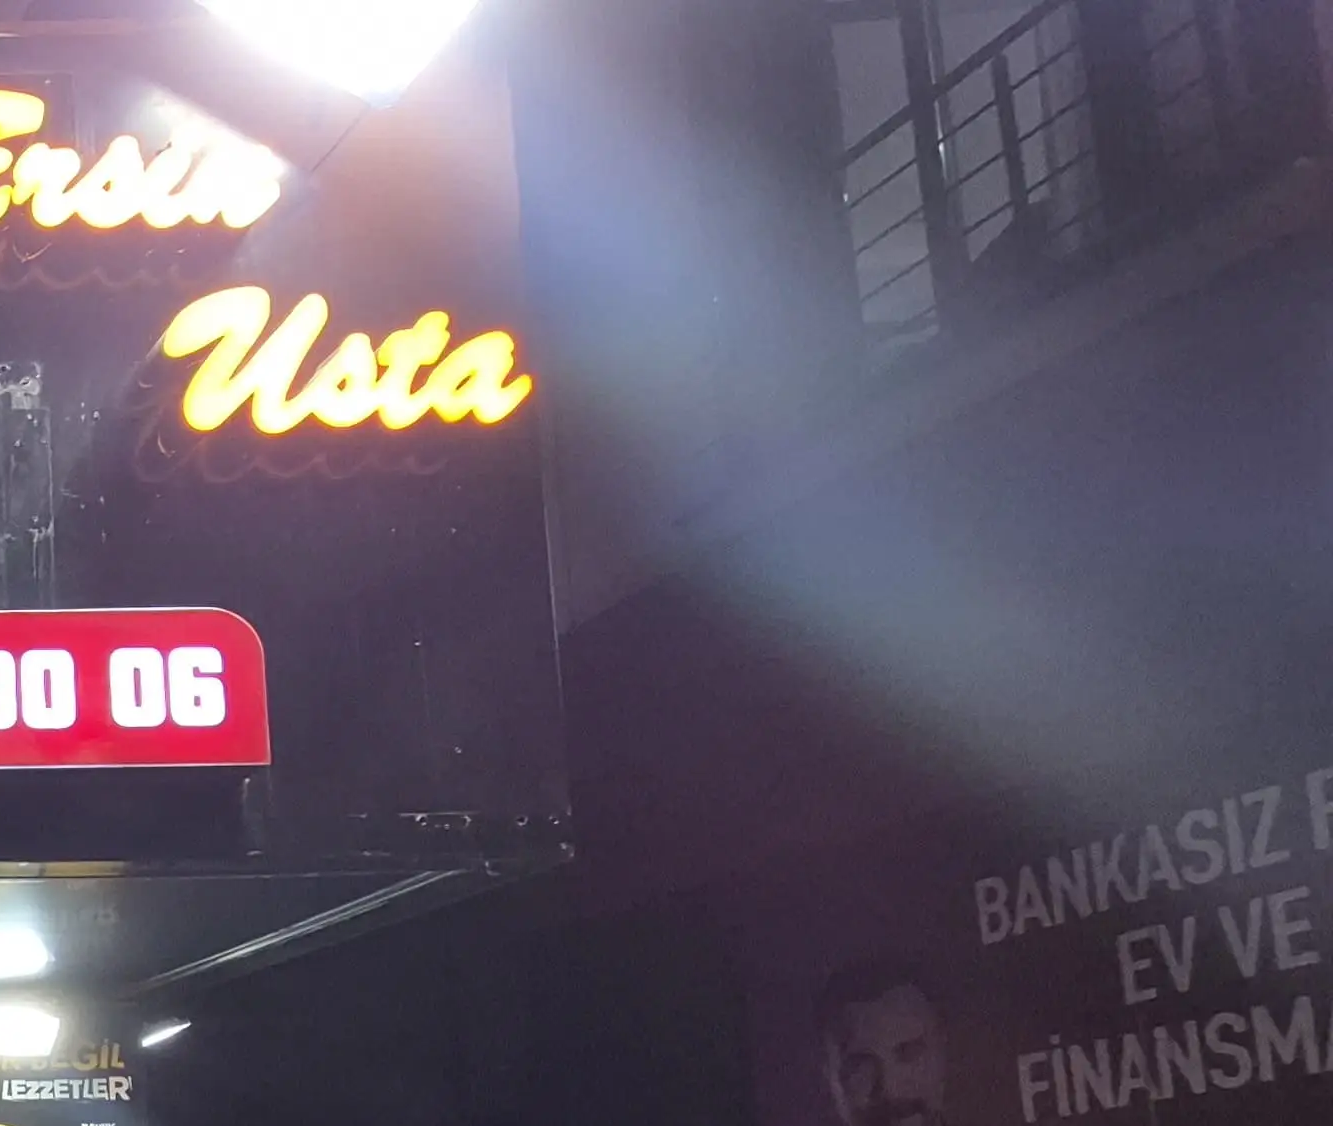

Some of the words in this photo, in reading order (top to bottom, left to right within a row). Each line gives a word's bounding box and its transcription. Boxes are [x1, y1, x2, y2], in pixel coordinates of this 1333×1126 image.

[162, 285, 532, 435] Usta
[108, 646, 227, 729] 06
[974, 785, 1291, 945] BANKASIZ
[1115, 916, 1197, 1005] EV
[1217, 886, 1322, 978] VE
[1, 1075, 133, 1101] LEZZETLER
[1016, 993, 1333, 1124] FİNANSM
